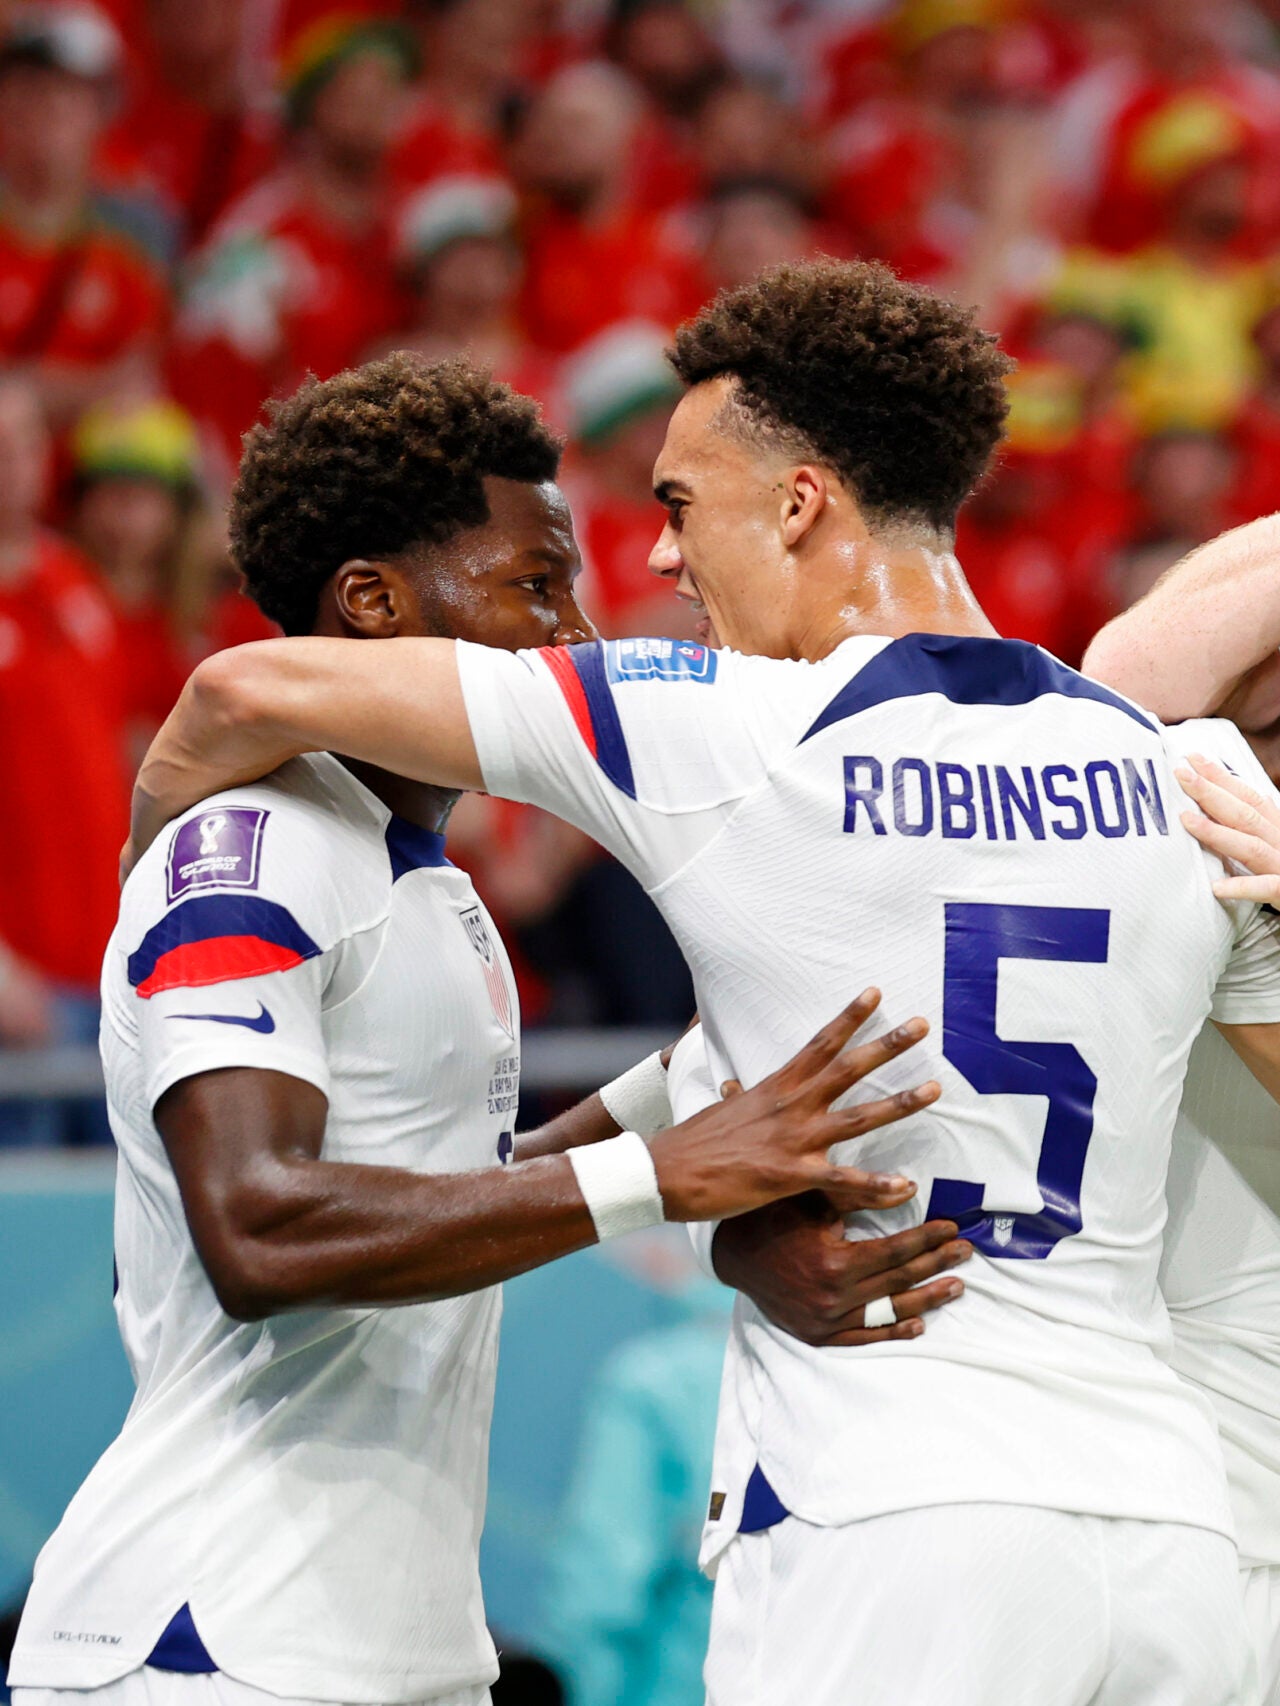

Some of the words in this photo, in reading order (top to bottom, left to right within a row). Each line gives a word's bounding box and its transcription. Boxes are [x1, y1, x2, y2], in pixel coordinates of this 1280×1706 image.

[842, 755, 1168, 841] ROBINSON
[925, 902, 1111, 1260] 5
[994, 1217, 1013, 1230] USA
